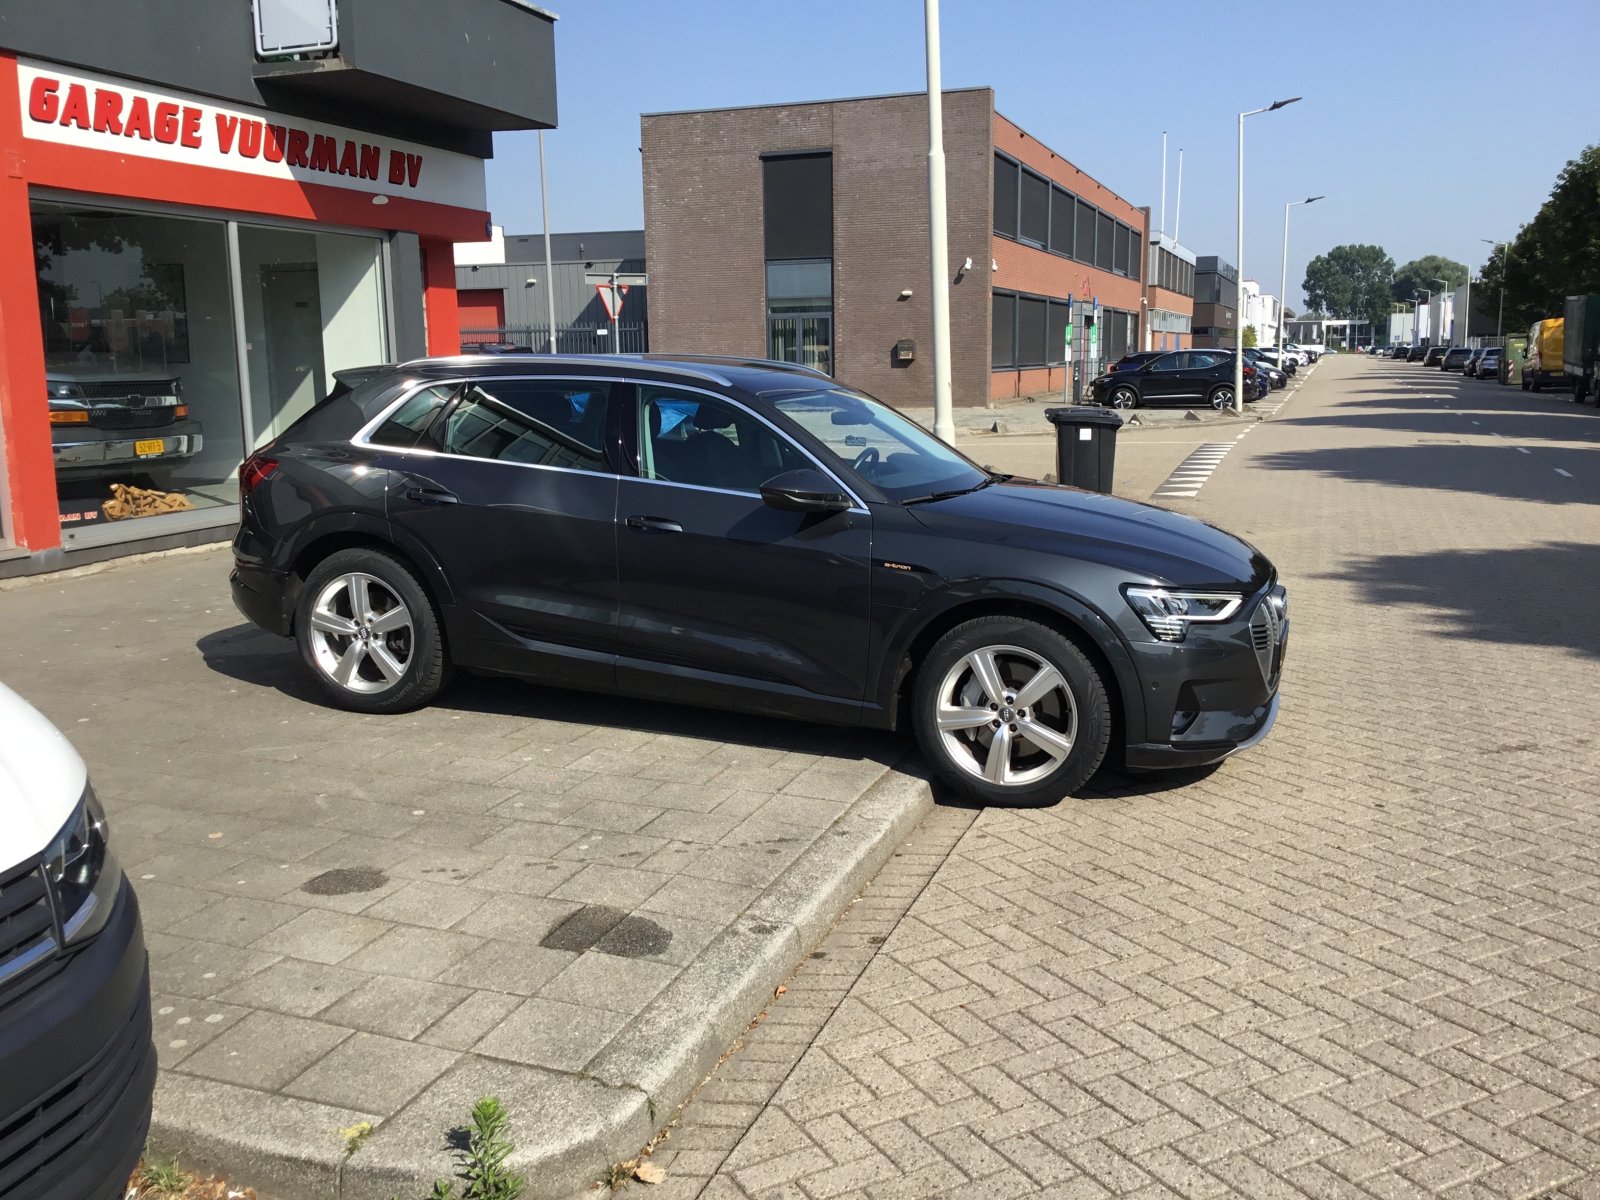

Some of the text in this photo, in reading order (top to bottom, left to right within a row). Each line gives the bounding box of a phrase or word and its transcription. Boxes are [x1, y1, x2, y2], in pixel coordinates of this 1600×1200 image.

[29, 76, 423, 188] GARAGE VUURMAN BV
